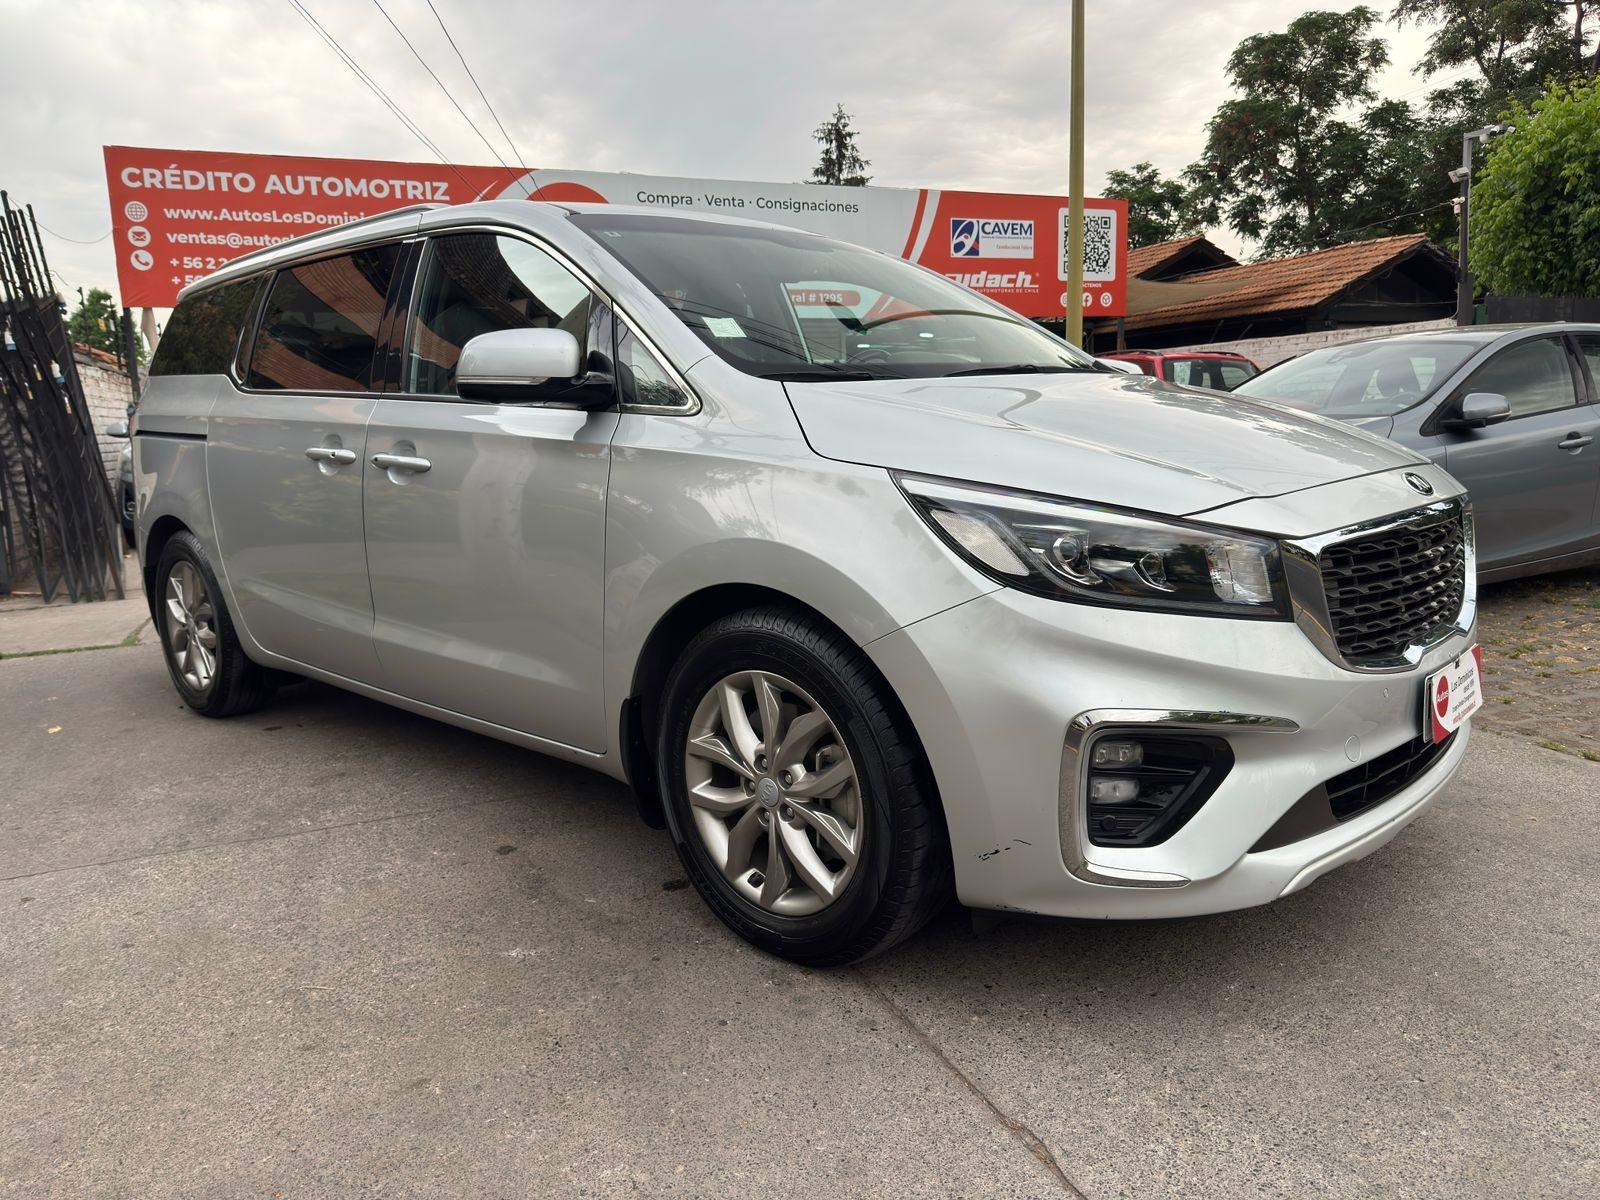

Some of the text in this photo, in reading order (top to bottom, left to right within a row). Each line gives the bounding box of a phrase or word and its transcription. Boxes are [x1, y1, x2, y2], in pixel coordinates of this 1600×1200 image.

[120, 164, 450, 201] CRÉDITO AUTOMOTRIZ
[636, 190, 859, 213] Compra Venta Consignaciones
[981, 221, 1033, 236] CAVEM
[183, 256, 204, 269] 56
[819, 293, 843, 303] 1295
